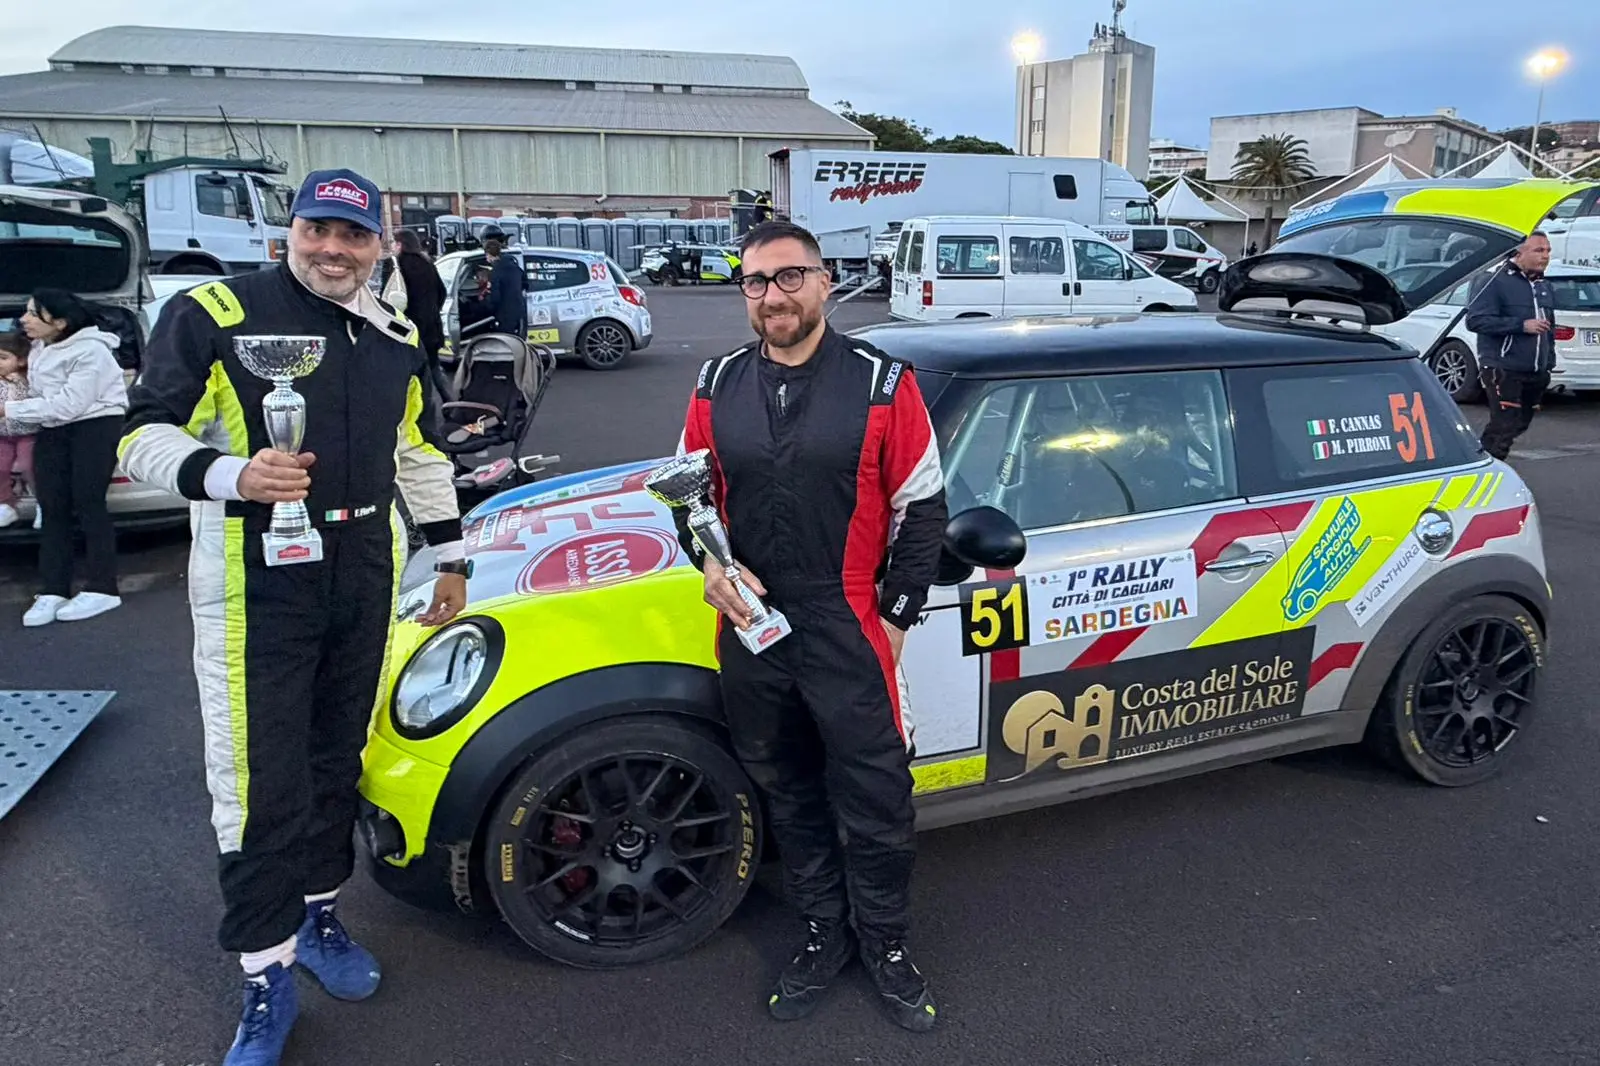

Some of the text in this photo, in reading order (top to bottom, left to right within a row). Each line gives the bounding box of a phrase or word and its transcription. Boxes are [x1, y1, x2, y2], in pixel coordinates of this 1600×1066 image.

[591, 263, 607, 281] 53
[1328, 414, 1382, 434] F. CANNAS
[1331, 435, 1392, 455] M. PIRRONI
[1388, 391, 1436, 463] 51
[1313, 499, 1354, 559] SAMUELE
[1320, 513, 1359, 571] ARGIOLU
[584, 539, 633, 585] ASSO
[1091, 557, 1167, 588] RALLY
[1324, 543, 1351, 581] AUTO
[971, 583, 1024, 647] 51
[1052, 589, 1090, 609] CITTÀ
[1093, 589, 1109, 602] DI
[1111, 578, 1174, 599] CAGLIARI
[1045, 597, 1188, 640] SARDEGNA
[1121, 655, 1294, 710] Costa del Sole
[1118, 681, 1299, 740] IMMOBILIARE
[1115, 741, 1164, 759] LUXURY
[1166, 734, 1195, 749] REAL
[1198, 724, 1237, 742] ESTATE
